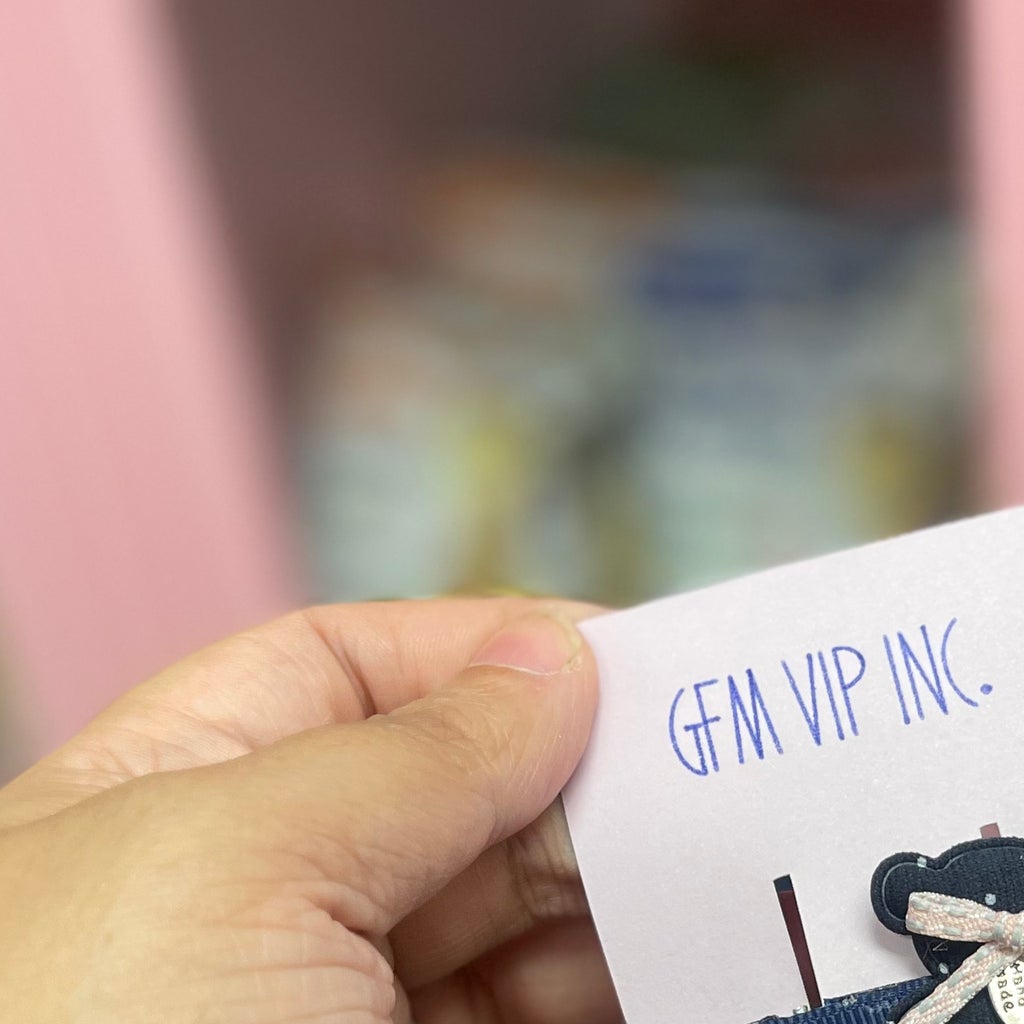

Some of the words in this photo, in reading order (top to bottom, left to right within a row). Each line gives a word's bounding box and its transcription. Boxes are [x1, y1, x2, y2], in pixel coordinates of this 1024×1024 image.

[668, 669, 784, 777] GFM
[782, 645, 866, 746] VIP
[883, 618, 994, 725] INC.
